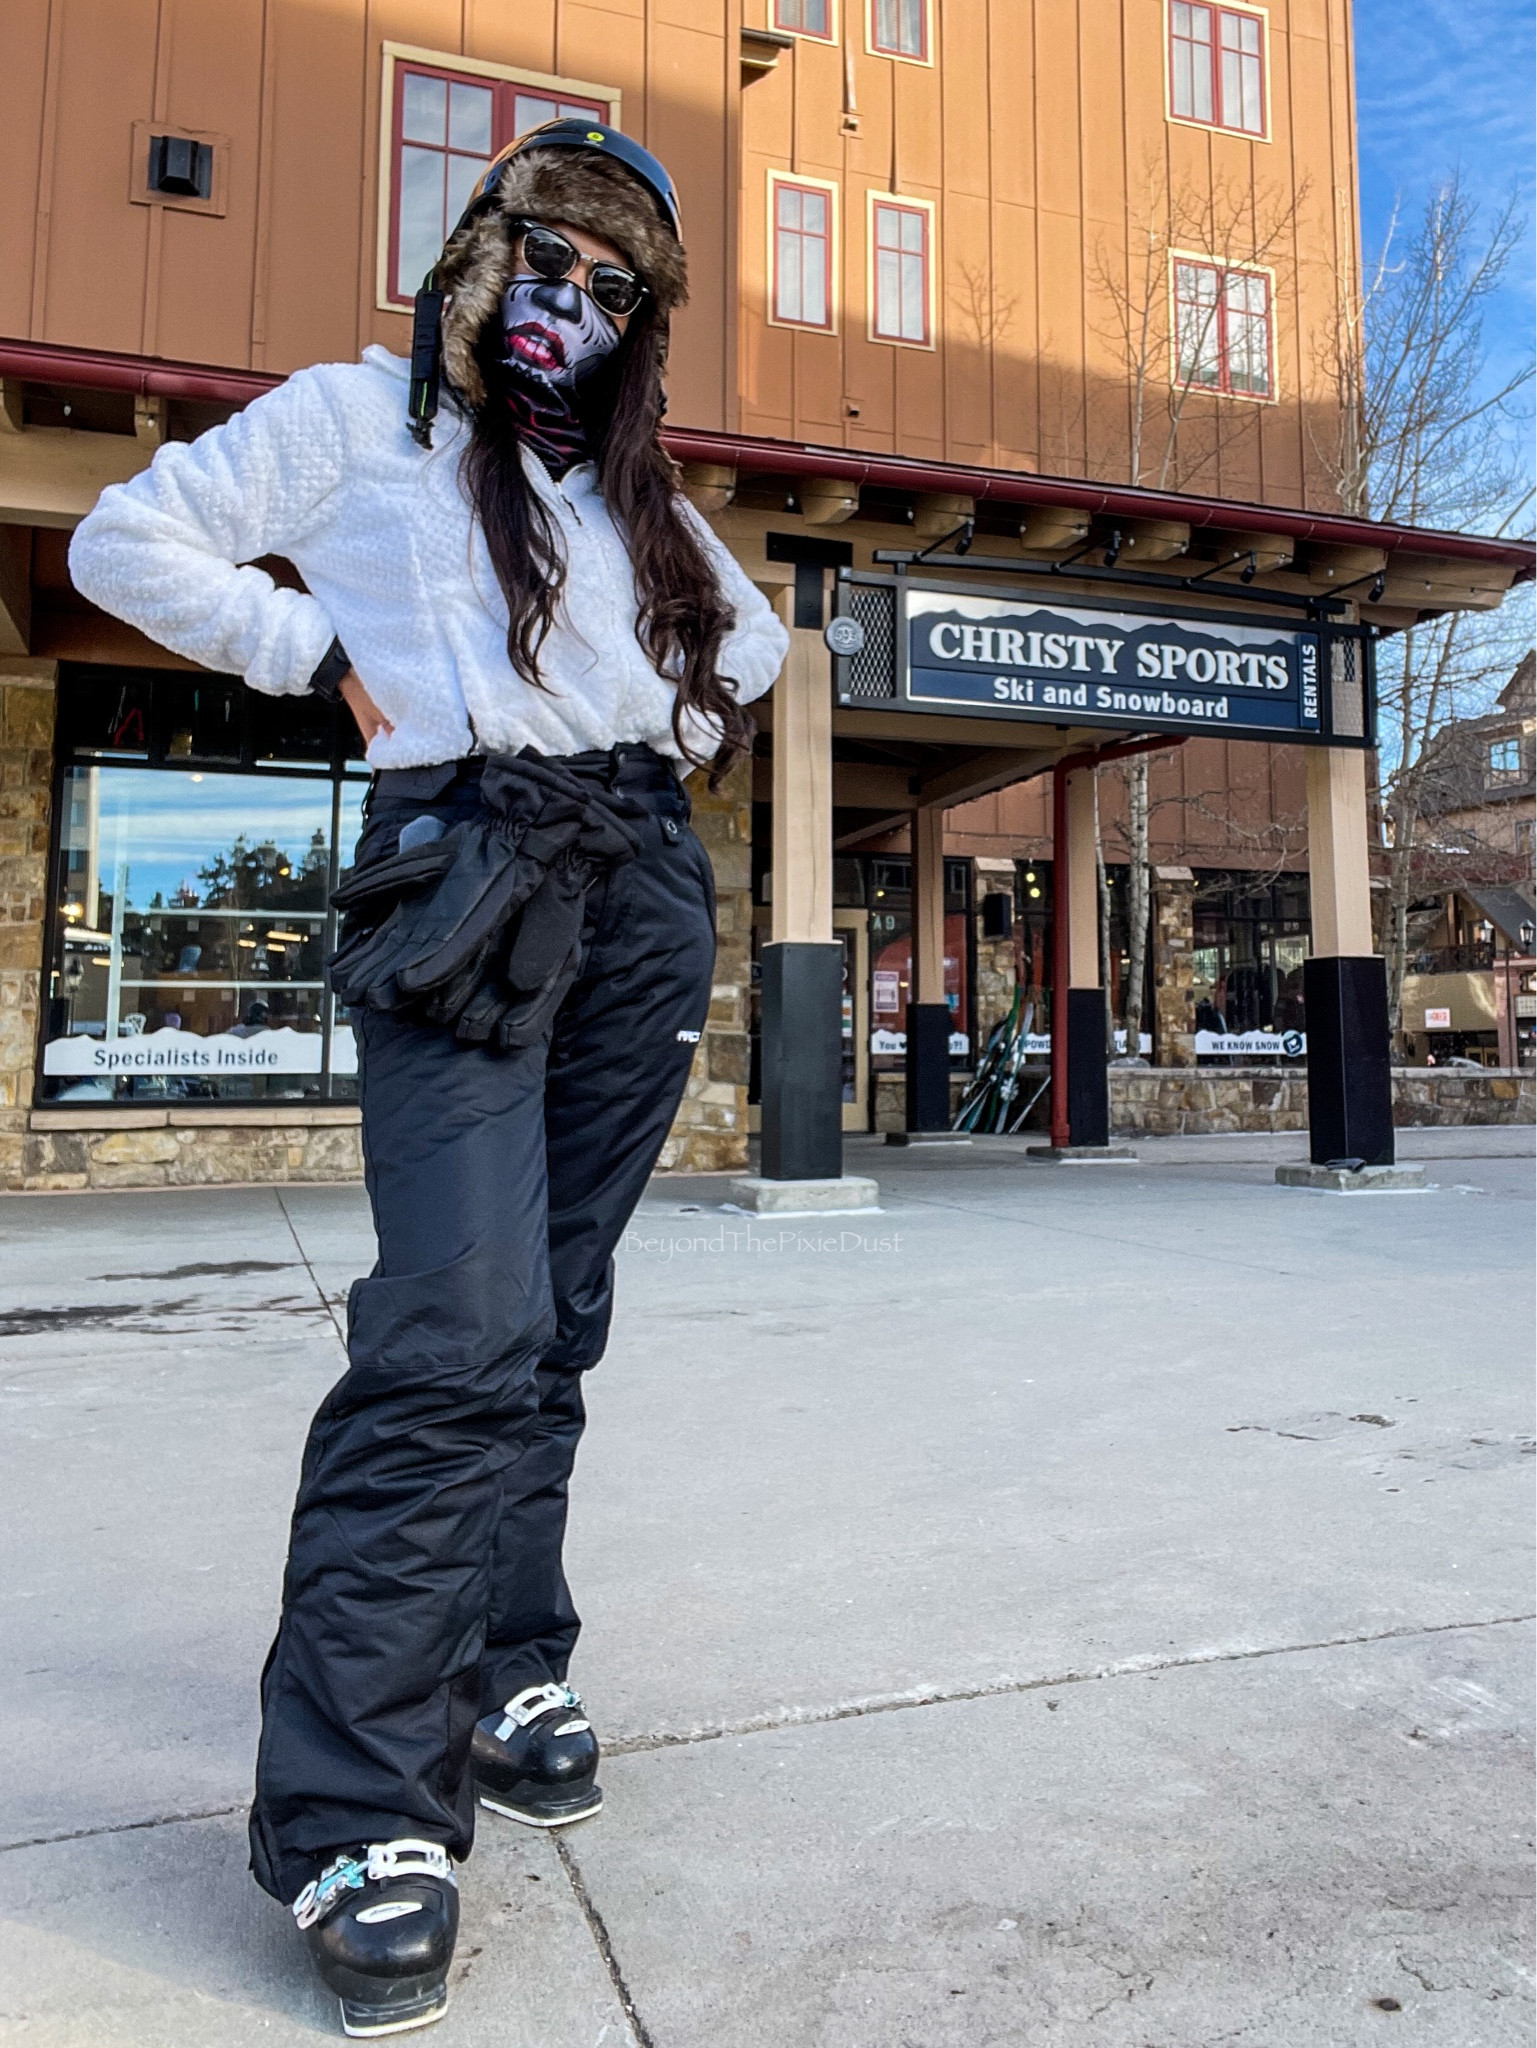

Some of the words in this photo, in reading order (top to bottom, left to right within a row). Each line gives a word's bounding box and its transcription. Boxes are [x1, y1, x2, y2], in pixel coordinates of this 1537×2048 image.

[929, 621, 1125, 674] CHRISTY
[1136, 642, 1290, 690] SPORTS
[1304, 643, 1317, 719] RENTALS
[993, 677, 1034, 703] Ski
[1043, 683, 1087, 707] and
[1096, 686, 1230, 719] Snowboard
[94, 1048, 210, 1069] Specialists
[217, 1049, 278, 1066] Inside
[879, 1041, 897, 1050] You
[1212, 1041, 1225, 1050] WE
[1228, 1041, 1253, 1050] KNOW
[1255, 1041, 1280, 1050] SNOW
